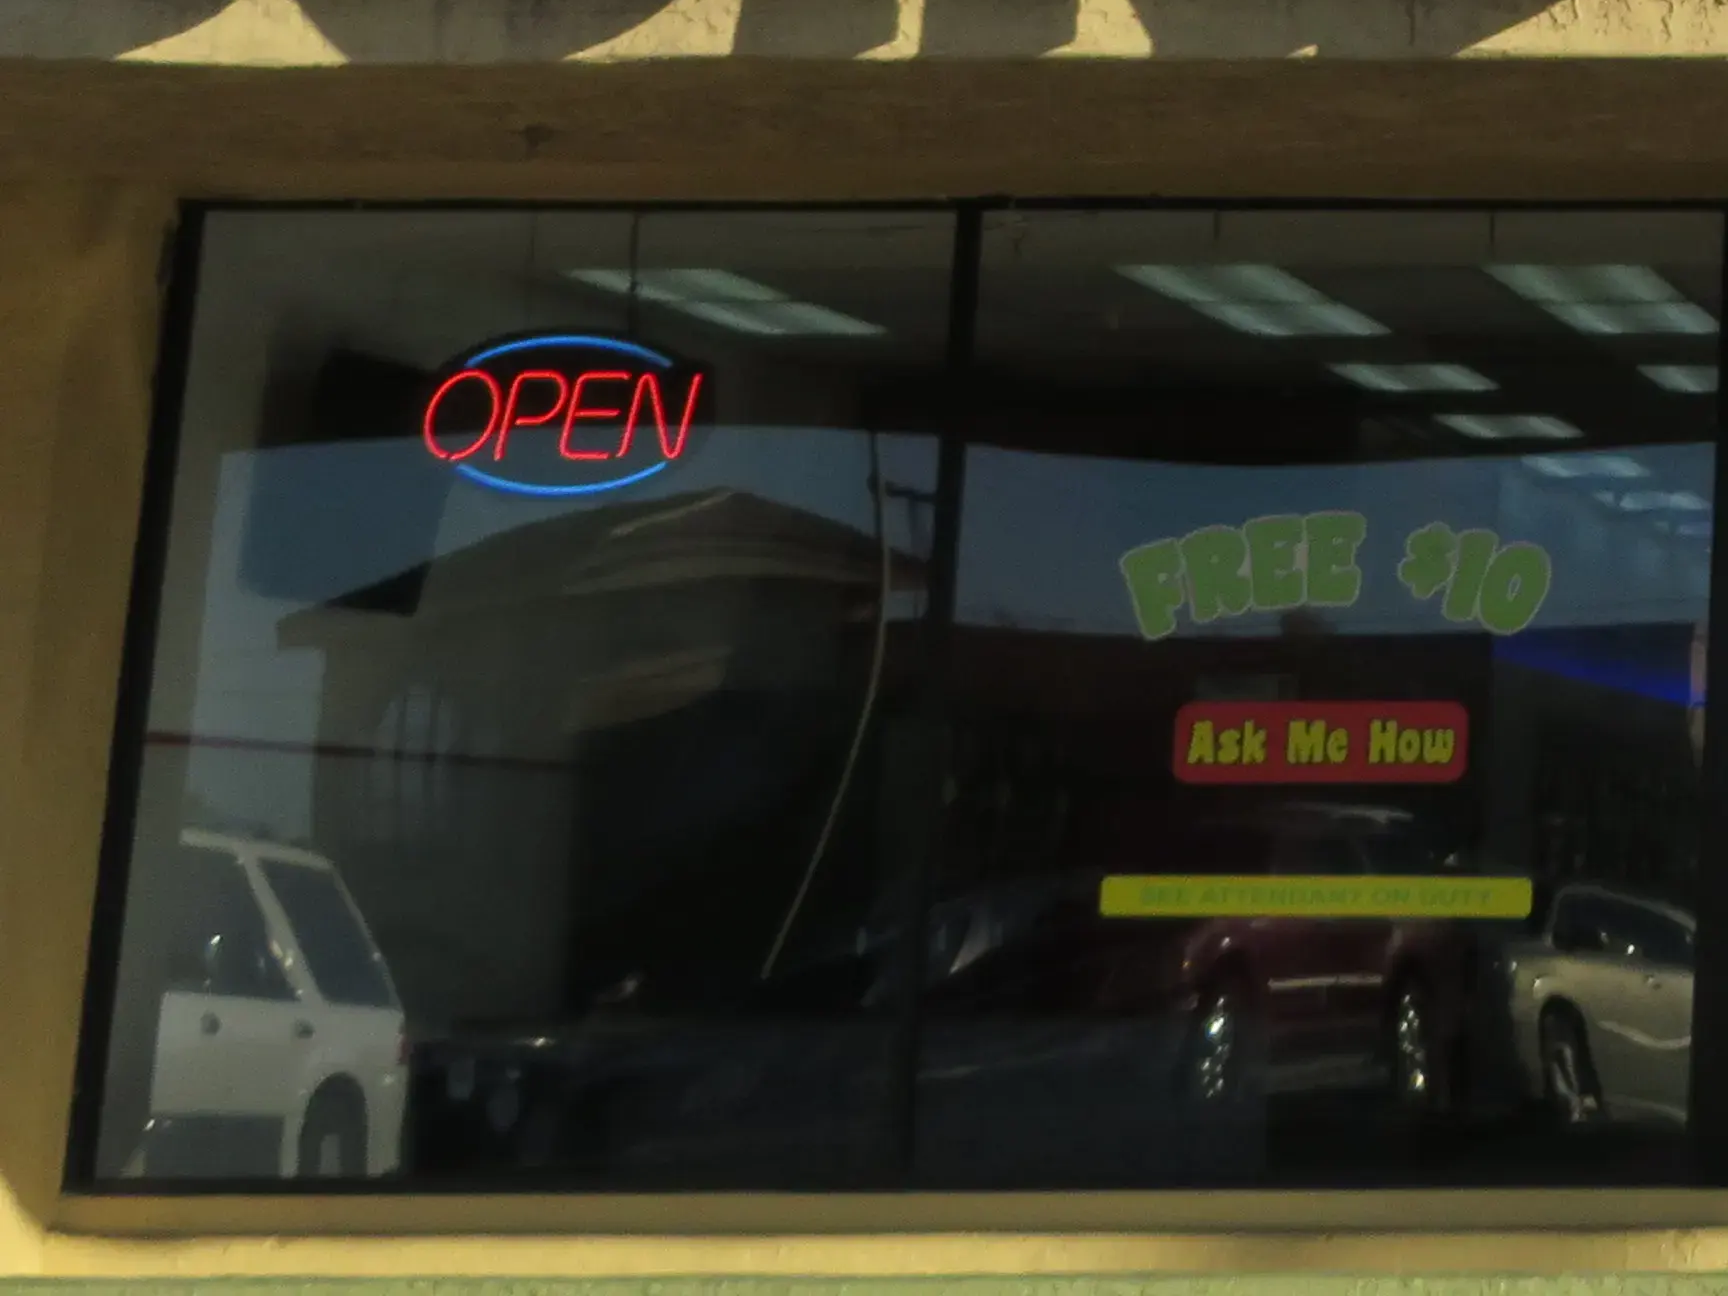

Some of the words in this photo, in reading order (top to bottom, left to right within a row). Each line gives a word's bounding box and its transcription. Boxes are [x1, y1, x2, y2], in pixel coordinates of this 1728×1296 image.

[423, 368, 703, 462] OPEN
[1119, 511, 1367, 640] FREE
[1397, 521, 1551, 635] $10
[1186, 720, 1267, 765] Ask
[1286, 720, 1348, 764] Me
[1369, 720, 1456, 764] How
